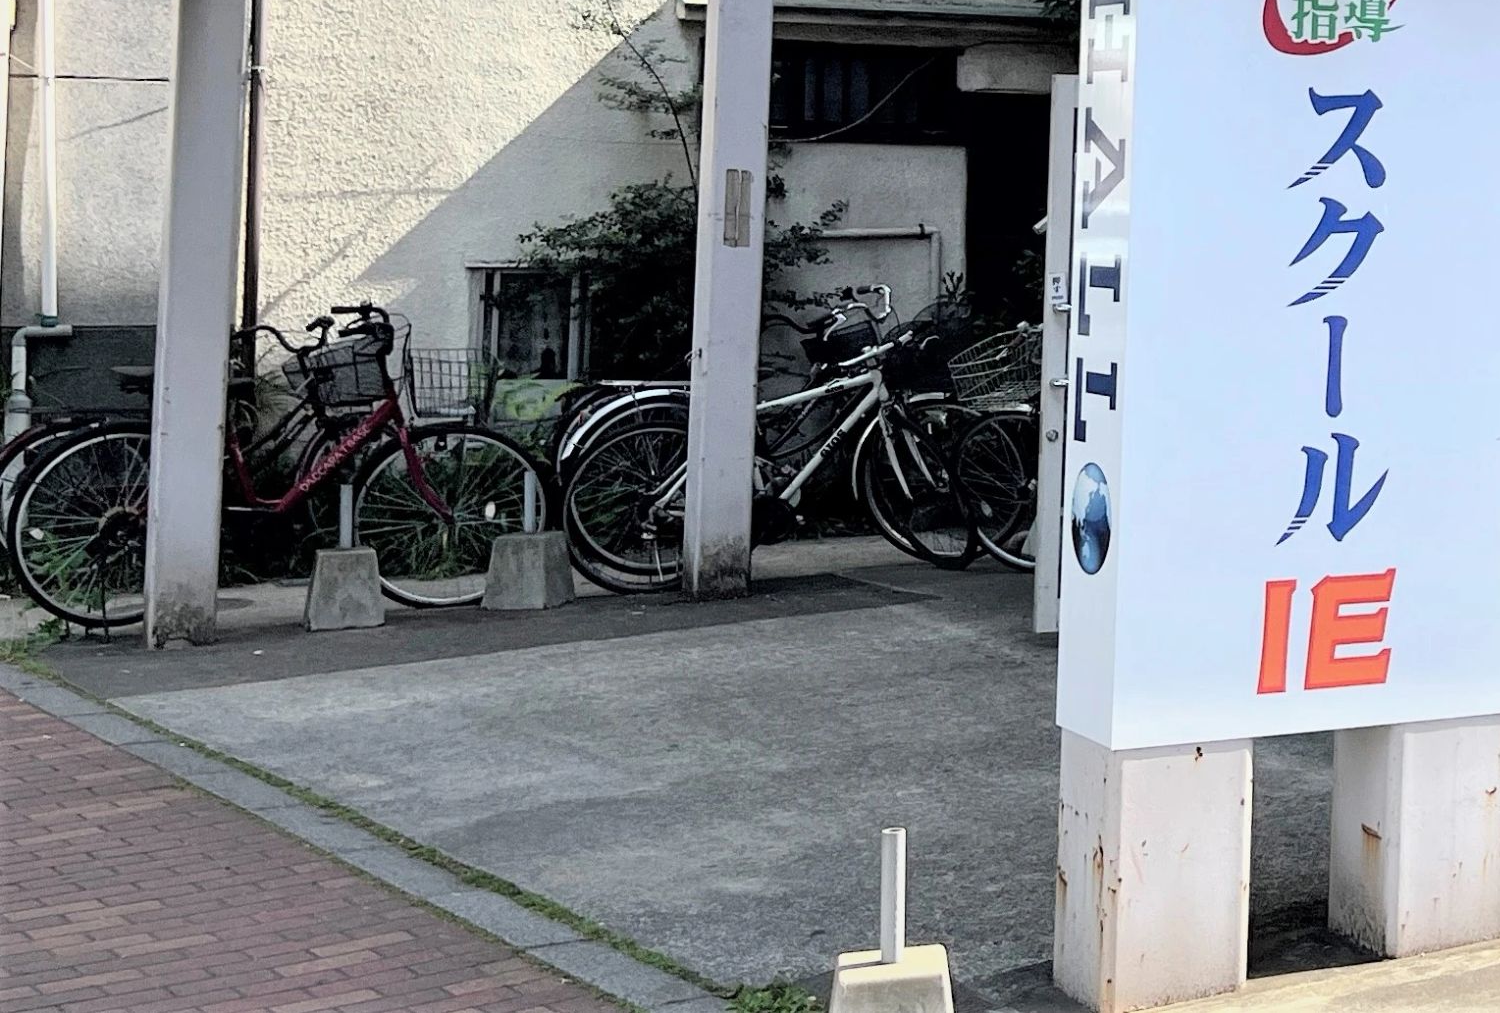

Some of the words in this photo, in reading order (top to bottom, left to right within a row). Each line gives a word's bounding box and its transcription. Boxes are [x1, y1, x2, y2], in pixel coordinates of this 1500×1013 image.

[1275, 87, 1390, 547] スクール
[1257, 568, 1397, 695] IE
